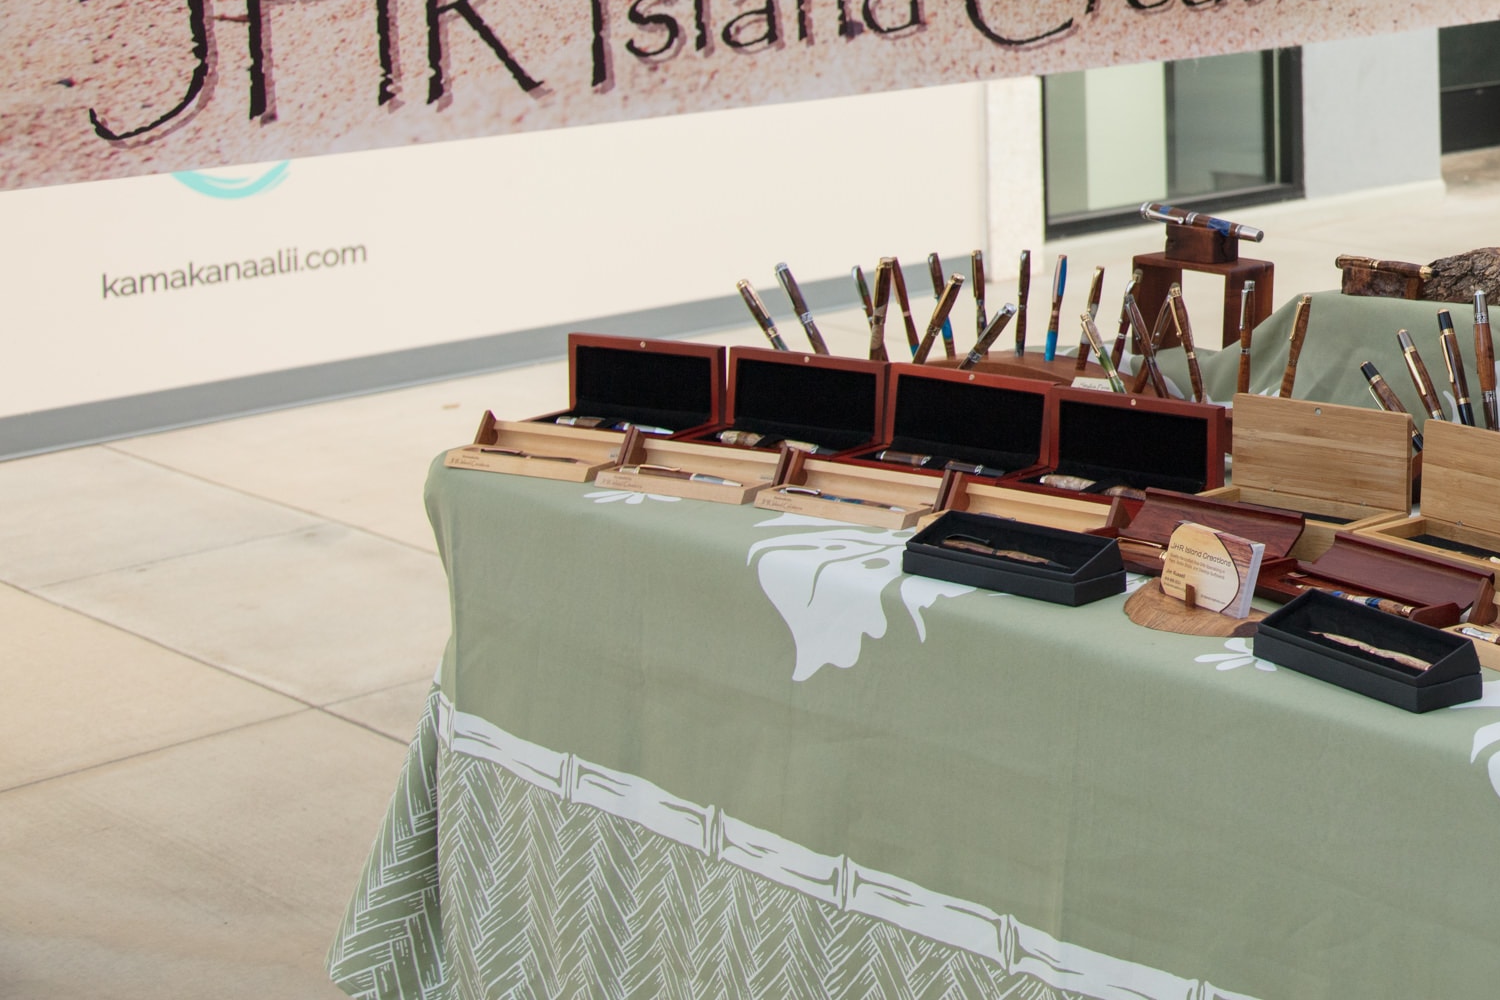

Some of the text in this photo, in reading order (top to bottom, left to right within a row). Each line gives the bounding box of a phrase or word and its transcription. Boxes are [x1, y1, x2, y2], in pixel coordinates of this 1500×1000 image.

[101, 243, 368, 299] kamakanaalii.com
[1185, 545, 1202, 558] Island
[1202, 552, 1232, 568] Creations
